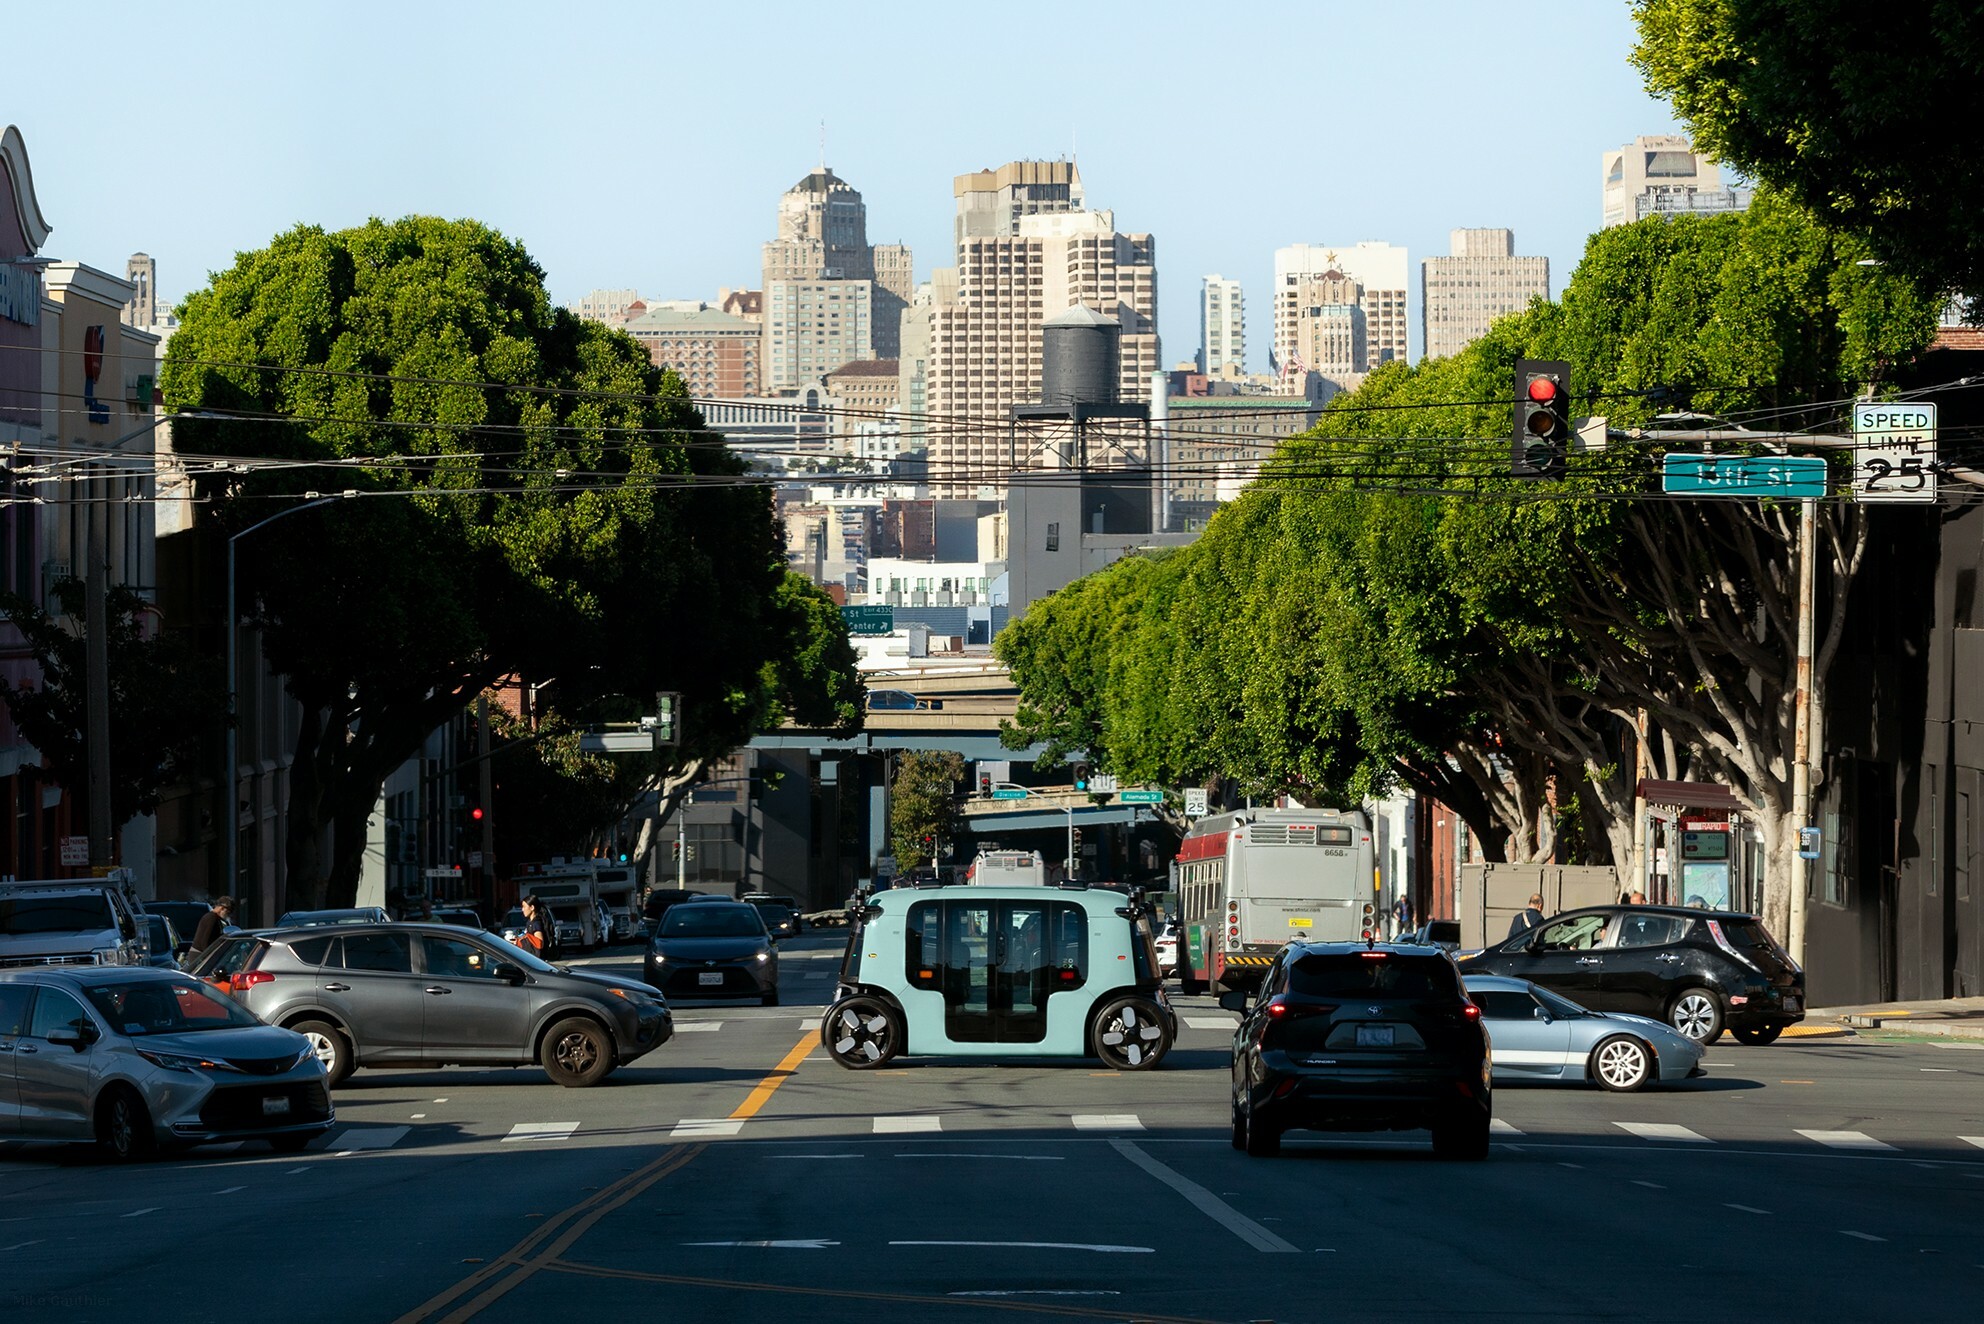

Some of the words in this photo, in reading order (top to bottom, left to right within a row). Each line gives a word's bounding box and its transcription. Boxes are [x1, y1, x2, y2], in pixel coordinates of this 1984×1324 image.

[1863, 413, 1928, 428] SPEED
[1868, 436, 1922, 450] LIMIT
[1767, 467, 1793, 487] St
[1864, 458, 1926, 493] 25
[849, 609, 859, 618] St
[1188, 802, 1205, 812] 25
[1324, 849, 1344, 857] 8658
